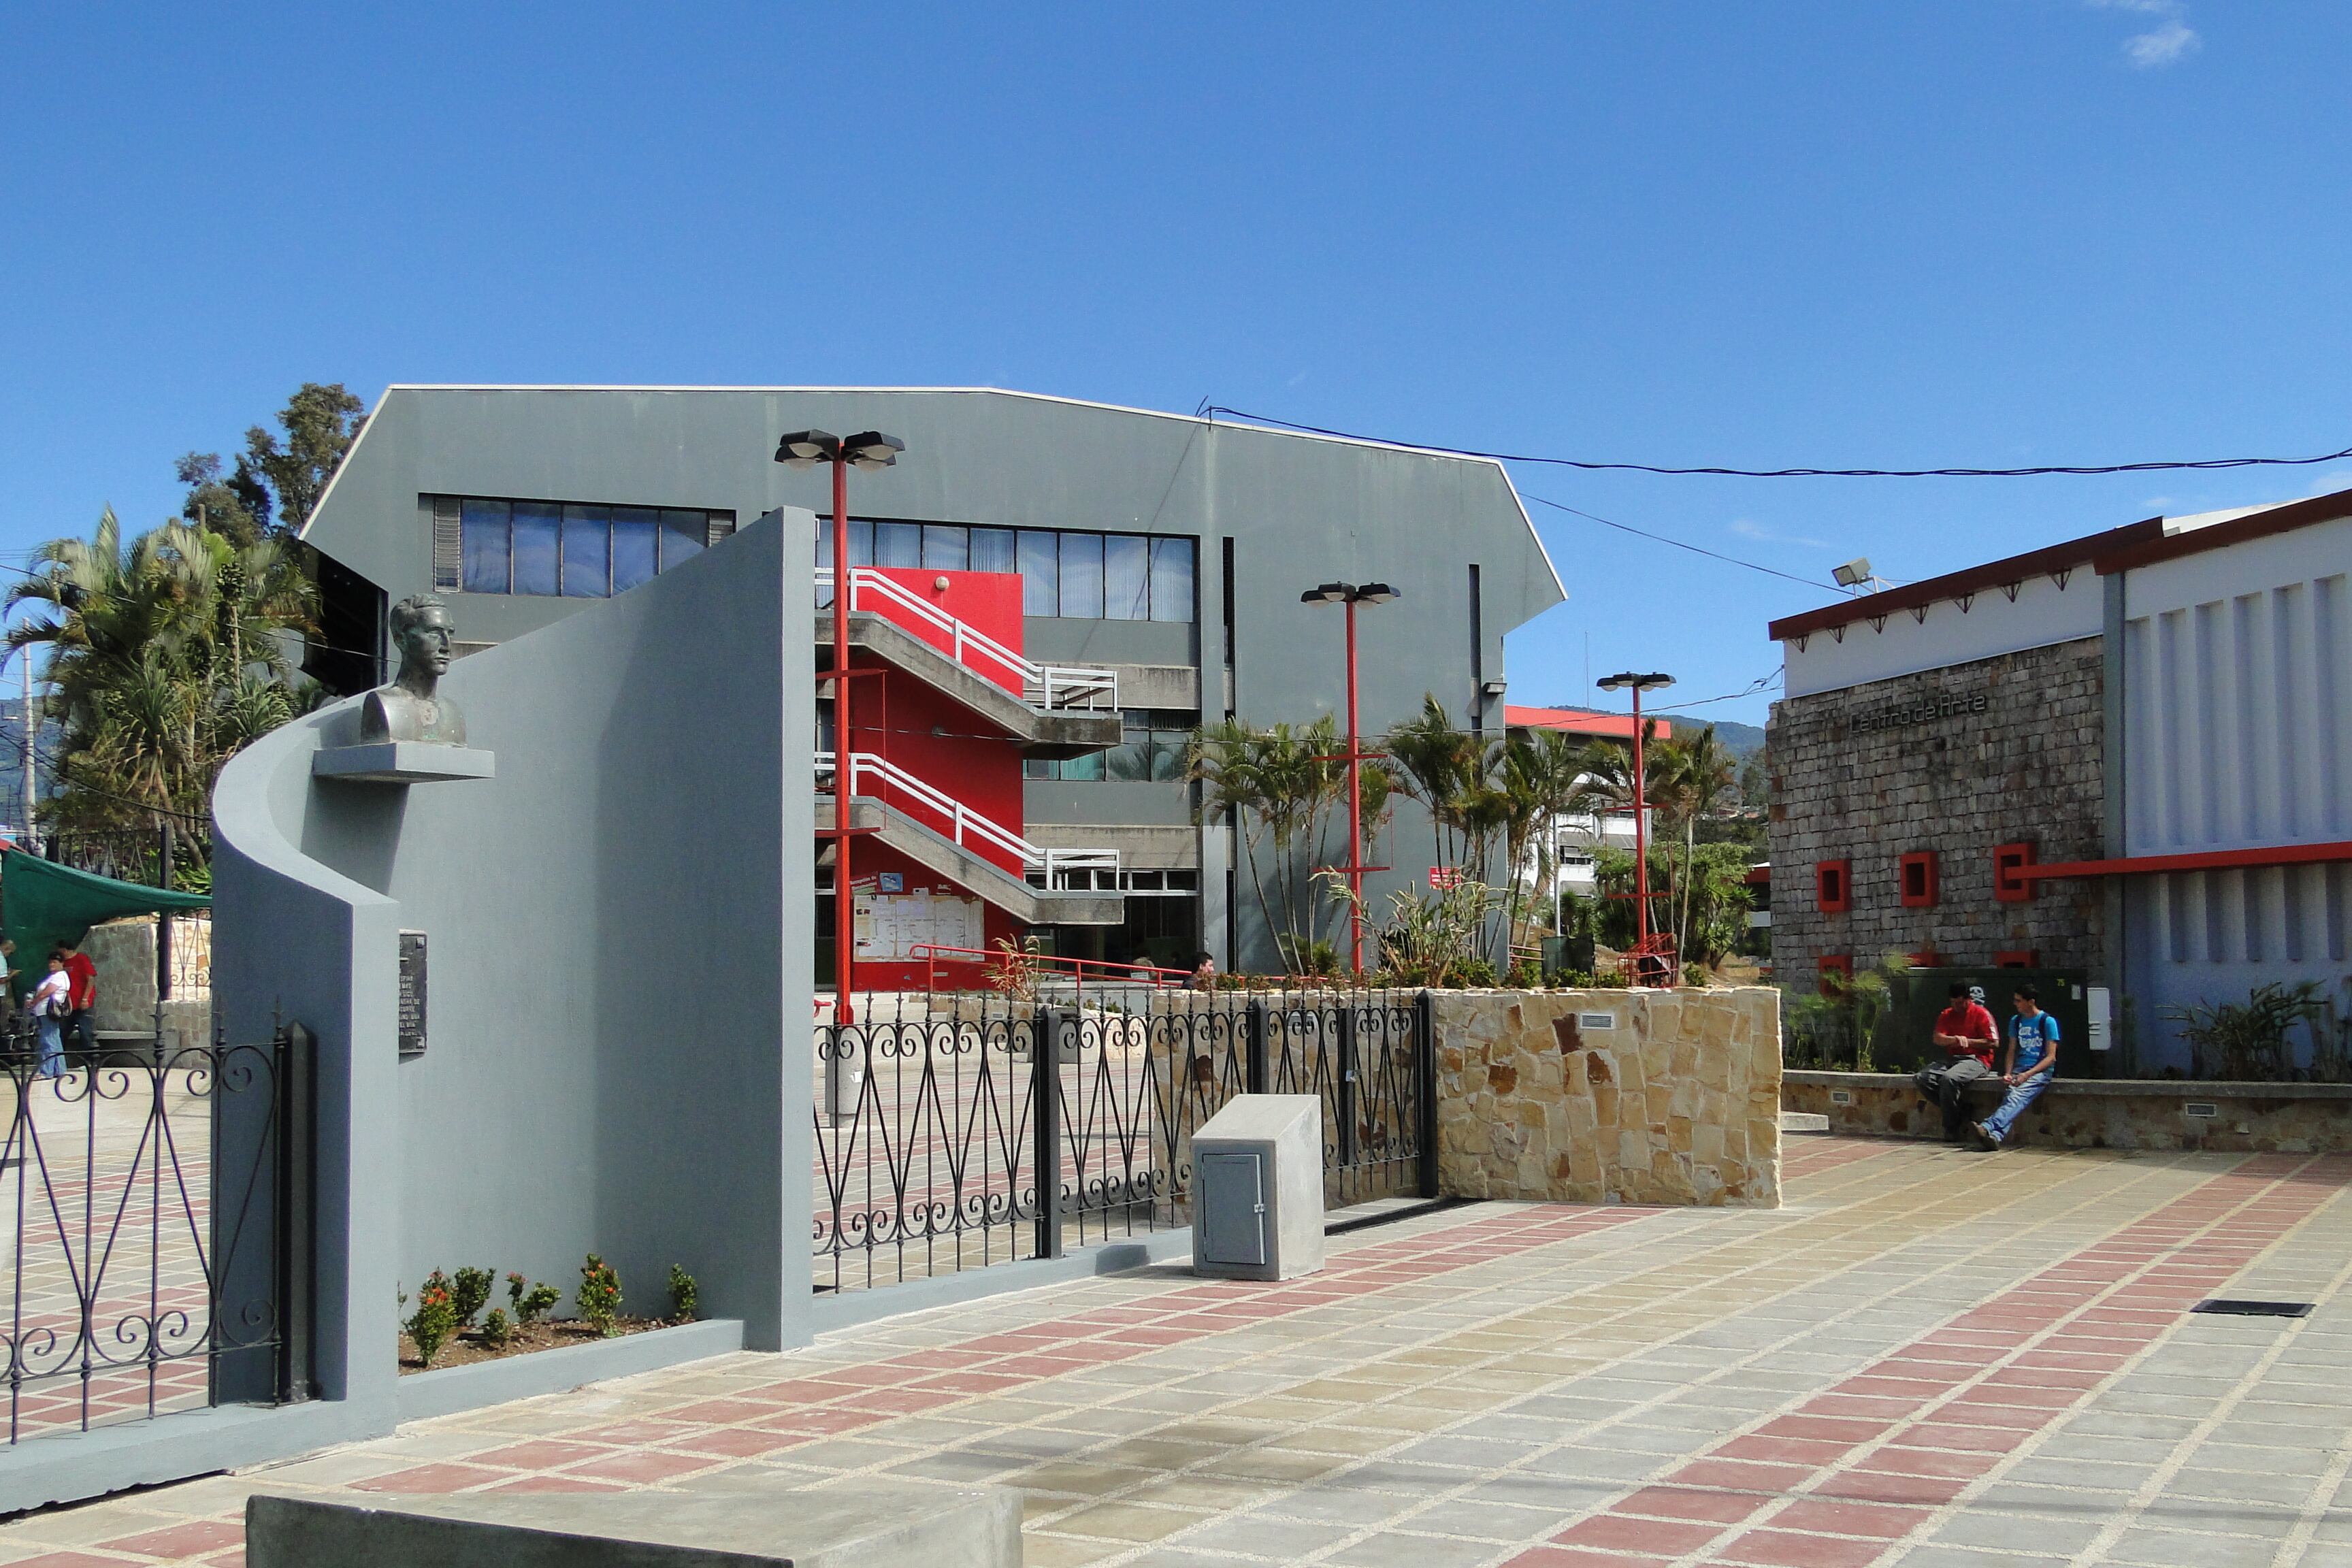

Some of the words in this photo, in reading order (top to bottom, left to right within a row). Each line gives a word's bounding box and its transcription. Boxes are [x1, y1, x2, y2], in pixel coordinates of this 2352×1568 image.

[1850, 708, 1910, 733] Centro
[1914, 700, 1936, 721] de
[1940, 694, 1985, 716] Arte
